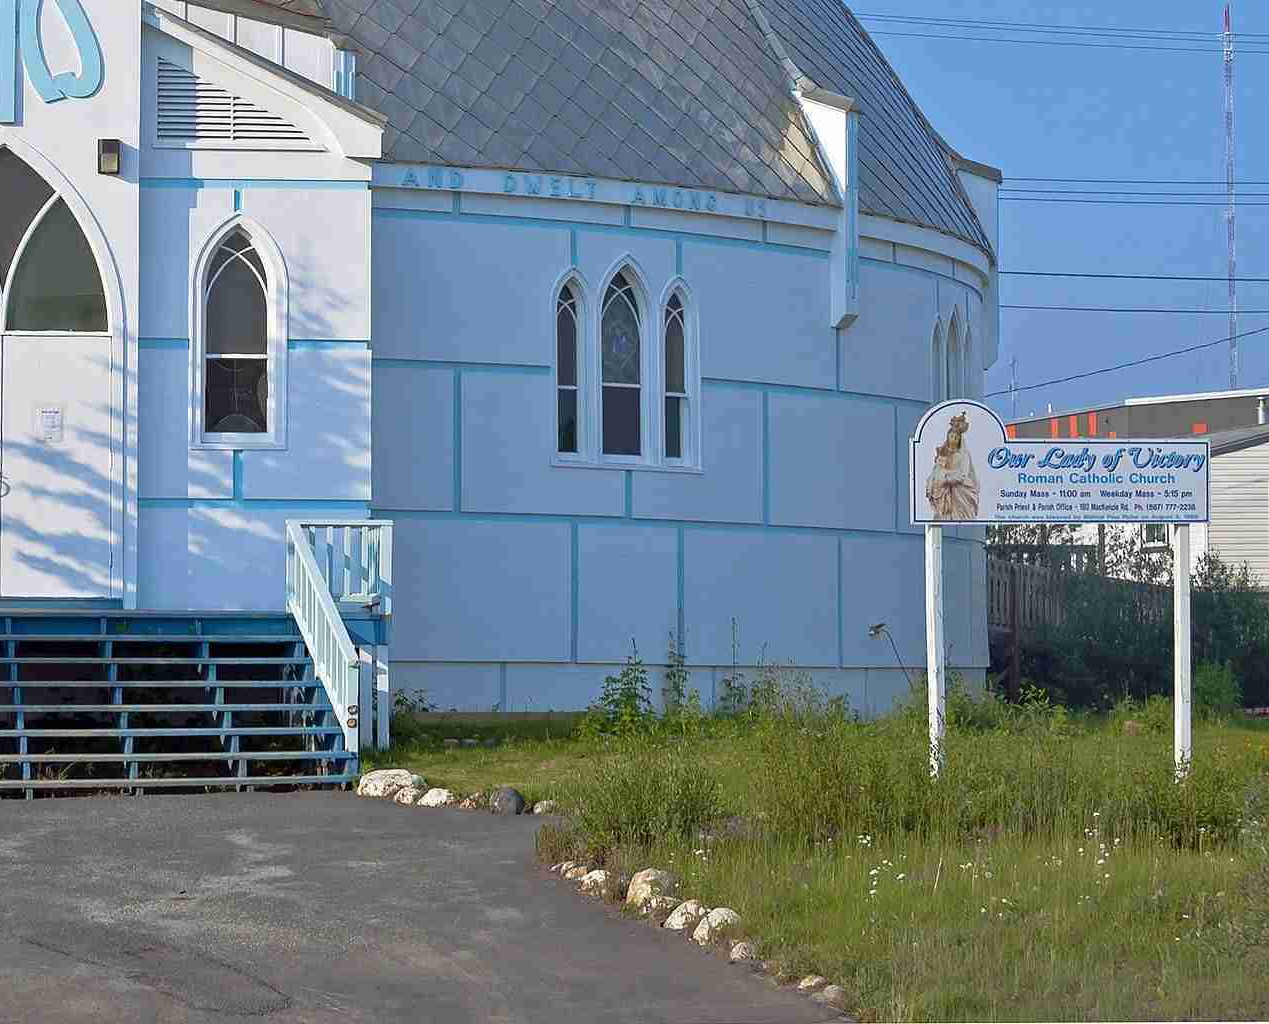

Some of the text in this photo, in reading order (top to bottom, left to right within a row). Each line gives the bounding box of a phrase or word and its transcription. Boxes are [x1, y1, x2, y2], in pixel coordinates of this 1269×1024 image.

[401, 167, 766, 218] AND DWELT AMONG US
[987, 446, 1206, 473] Our Lady of Victory
[1018, 472, 1176, 484] Roman Catholic Church
[1000, 490, 1027, 499] Sunday
[1030, 490, 1049, 498] Mass
[1099, 489, 1133, 499] Weekday
[1135, 490, 1155, 498] Mass
[1164, 489, 1179, 498] 5:15
[1181, 491, 1193, 499] pm
[996, 503, 1013, 511] Parish
[1014, 503, 1030, 511] Priest
[1032, 503, 1036, 511] &
[1037, 503, 1055, 511] Parish
[1055, 503, 1073, 511] Office
